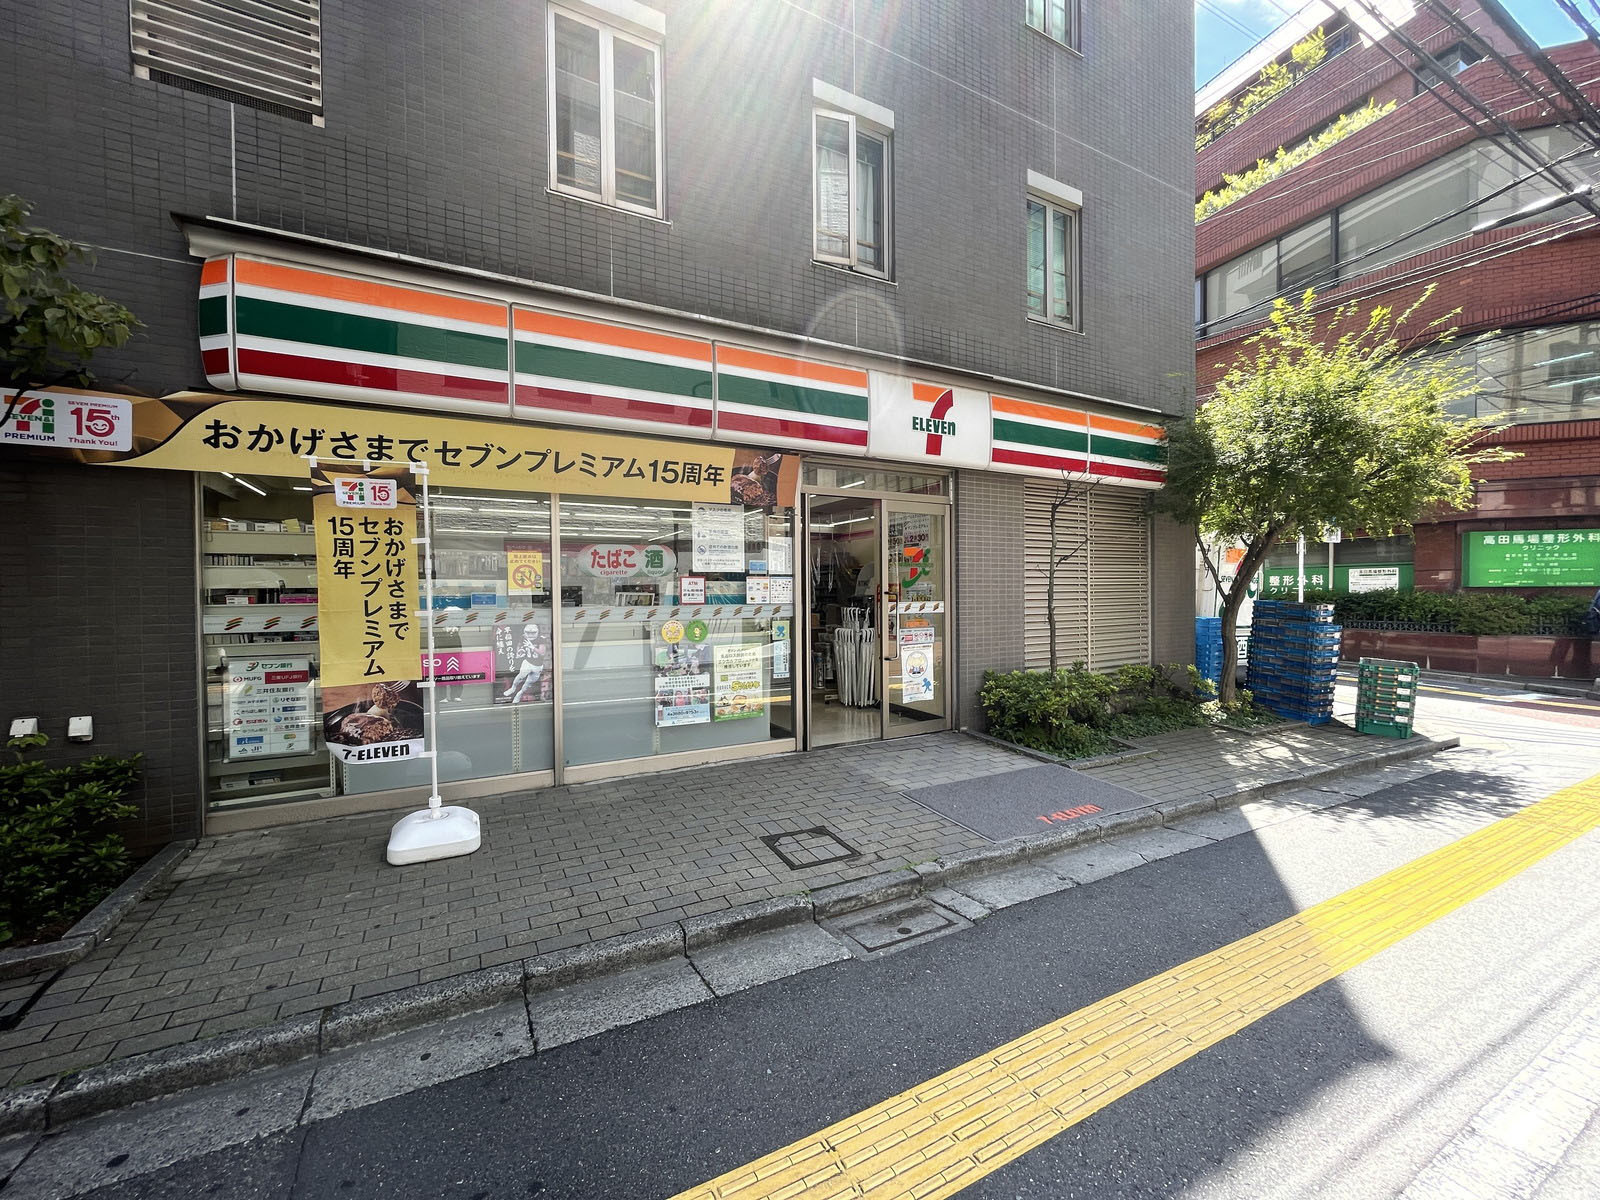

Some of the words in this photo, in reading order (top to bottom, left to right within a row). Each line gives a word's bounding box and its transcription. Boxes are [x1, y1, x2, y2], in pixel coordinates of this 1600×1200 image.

[9, 413, 55, 423] EVEN&i
[4, 432, 55, 442] PREMIUM
[68, 437, 97, 445] Thank
[202, 419, 724, 488] おかげさまでセブンプレミアム15周年
[327, 516, 356, 579] 15周年
[591, 549, 637, 569] たばこ
[645, 549, 664, 569] 酒
[383, 517, 410, 641] おかげさまで
[358, 516, 386, 677] セブンプレミアム
